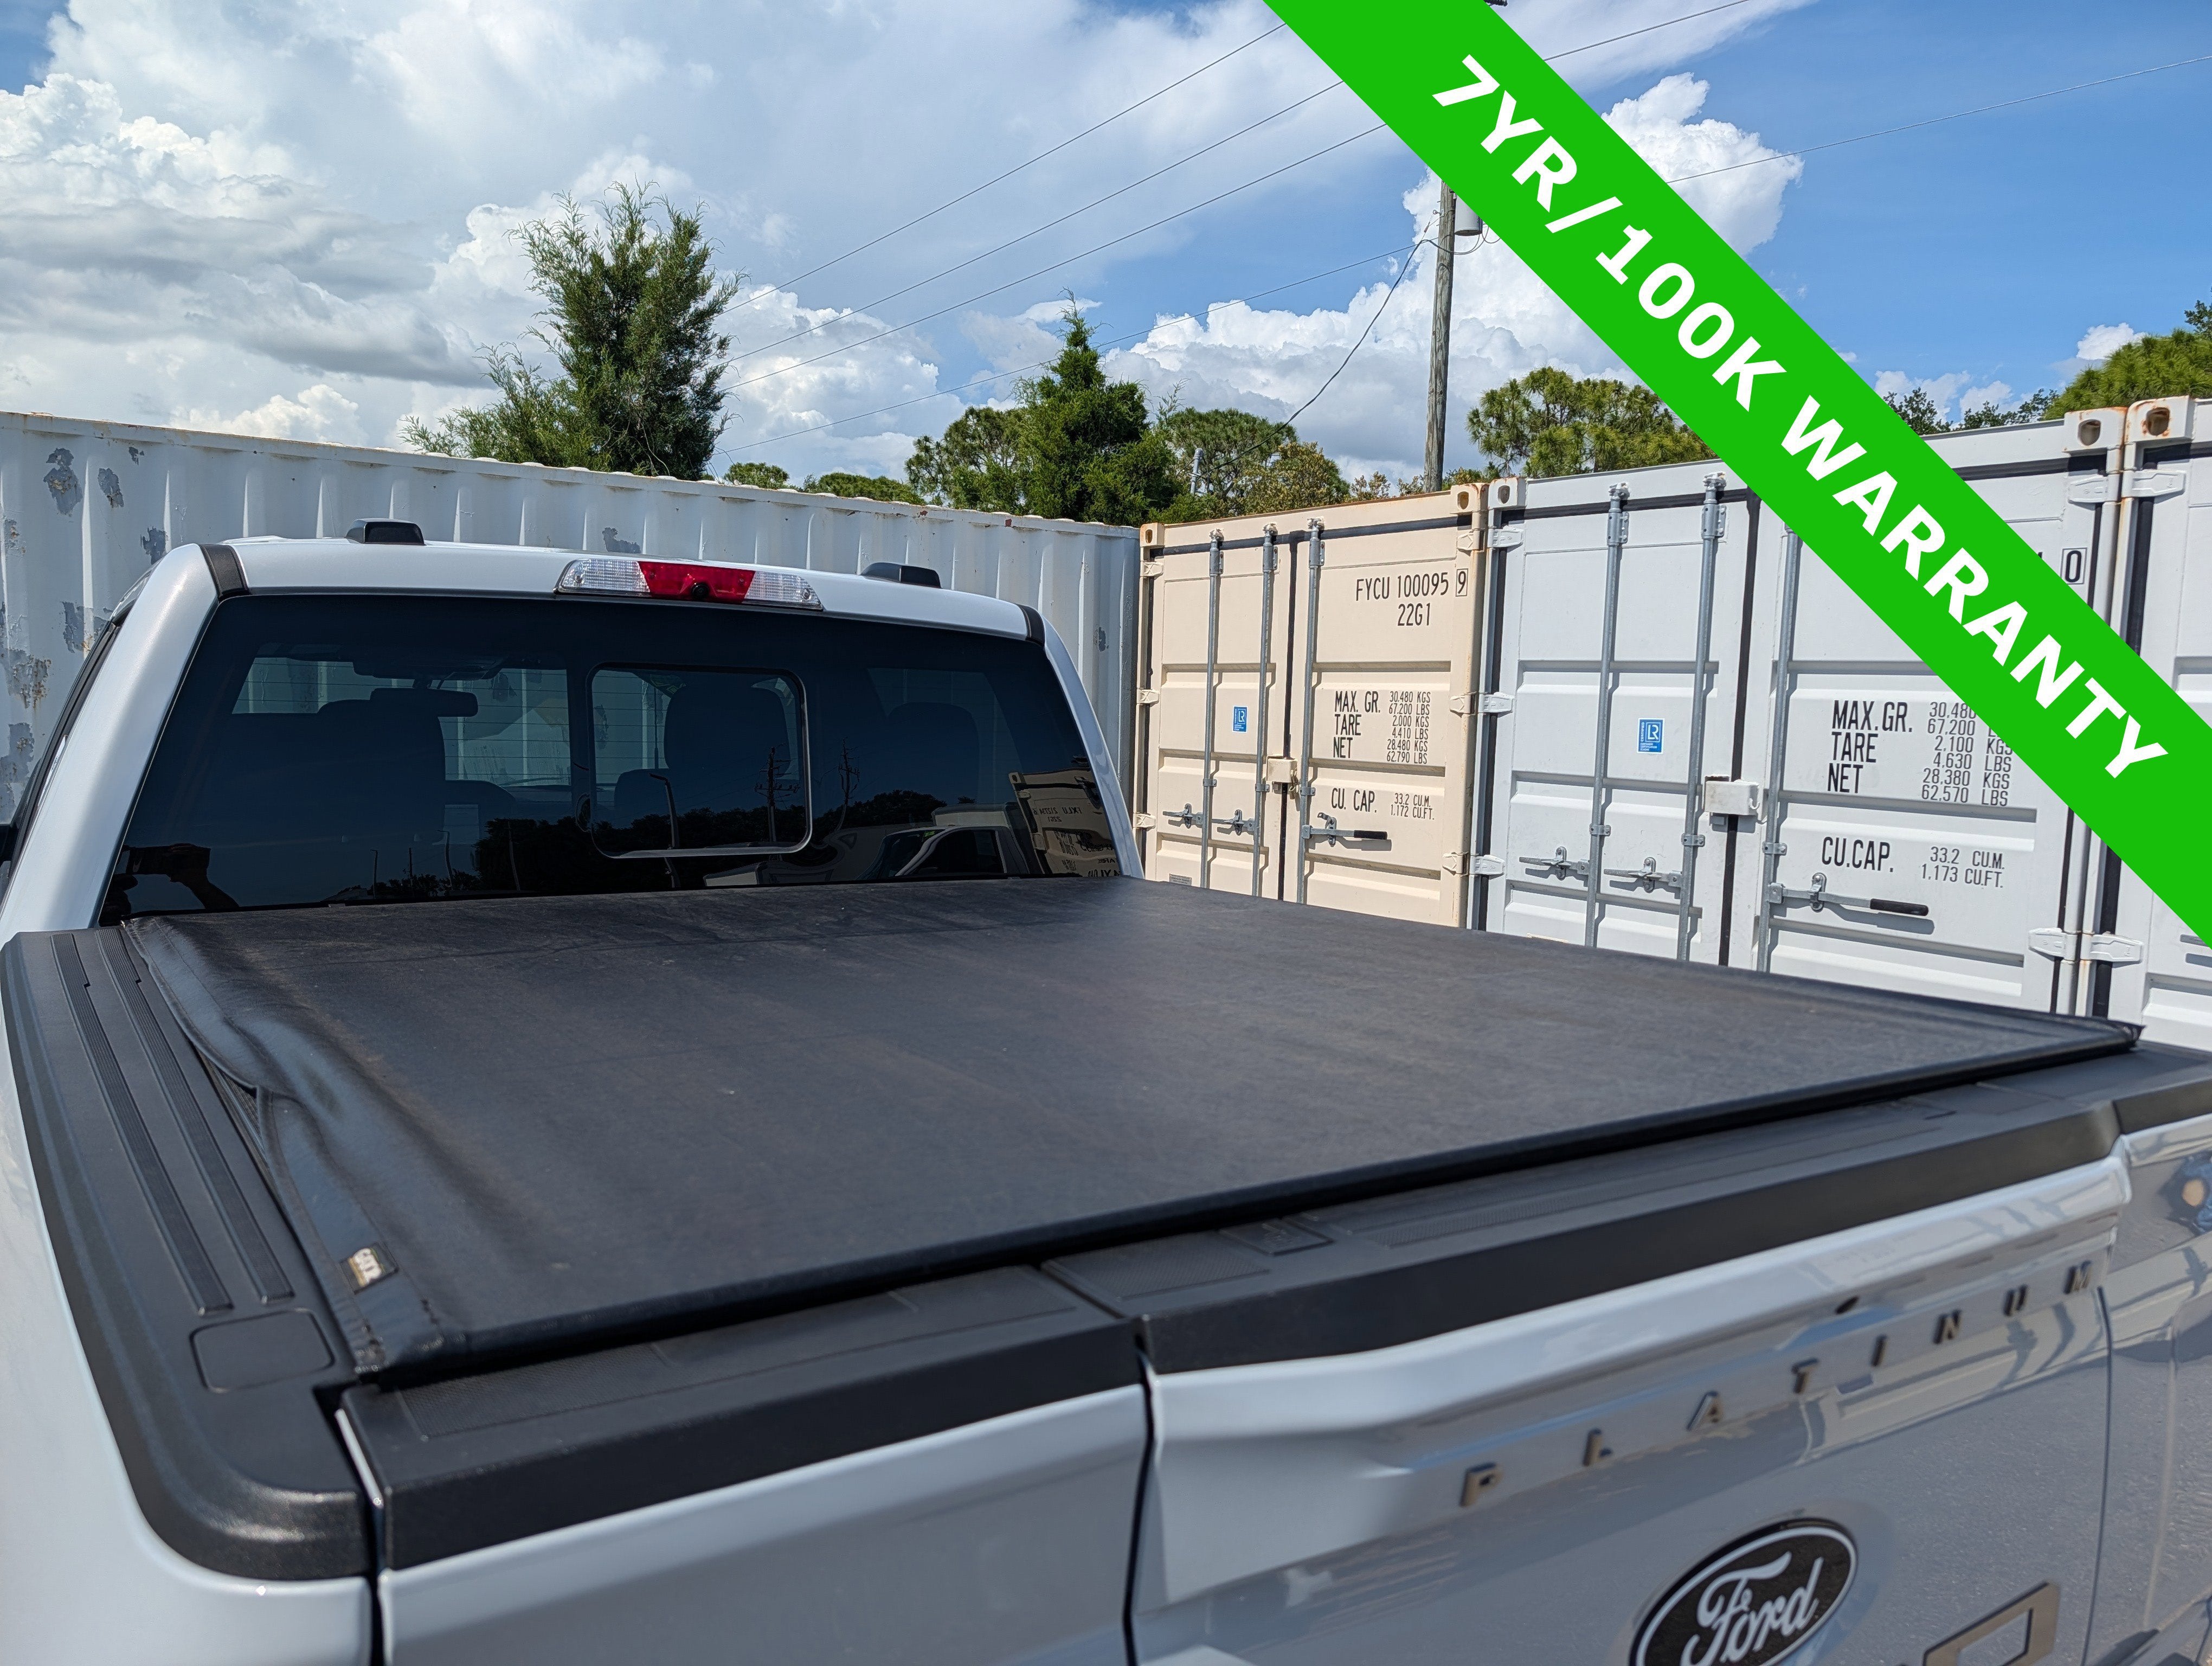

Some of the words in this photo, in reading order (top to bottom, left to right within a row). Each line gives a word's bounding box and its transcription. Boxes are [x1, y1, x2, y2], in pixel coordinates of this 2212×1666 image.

[1355, 576, 1390, 601] FYCU
[1397, 572, 1449, 598] 100095
[1457, 571, 1466, 594] 9
[1397, 603, 1431, 626] 22G1
[1334, 690, 1359, 712] MAX.
[1364, 691, 1381, 713] GR.
[1416, 691, 1431, 703] KGS
[1416, 704, 1430, 715] LBS
[1334, 714, 1362, 736] TARE
[1415, 716, 1430, 728] KGS
[1414, 728, 1429, 740] LBS
[1333, 736, 1353, 759] NET
[1414, 740, 1428, 752] KGS
[1831, 731, 1879, 763] TARE
[1986, 739, 2013, 755] KGS
[1413, 752, 1427, 764] LBS
[1984, 755, 2012, 772] LBS
[1827, 762, 1863, 794] NET
[1983, 772, 2010, 790] KGS
[1331, 787, 1346, 810] CU.
[1353, 789, 1377, 813] CAP.
[1394, 792, 1410, 805] 33.2
[1981, 789, 2008, 807] LBS
[1930, 846, 1960, 864] 33.2
[1459, 1260, 2092, 1507] PLATINUM
[1680, 1552, 1824, 1666] Ford
